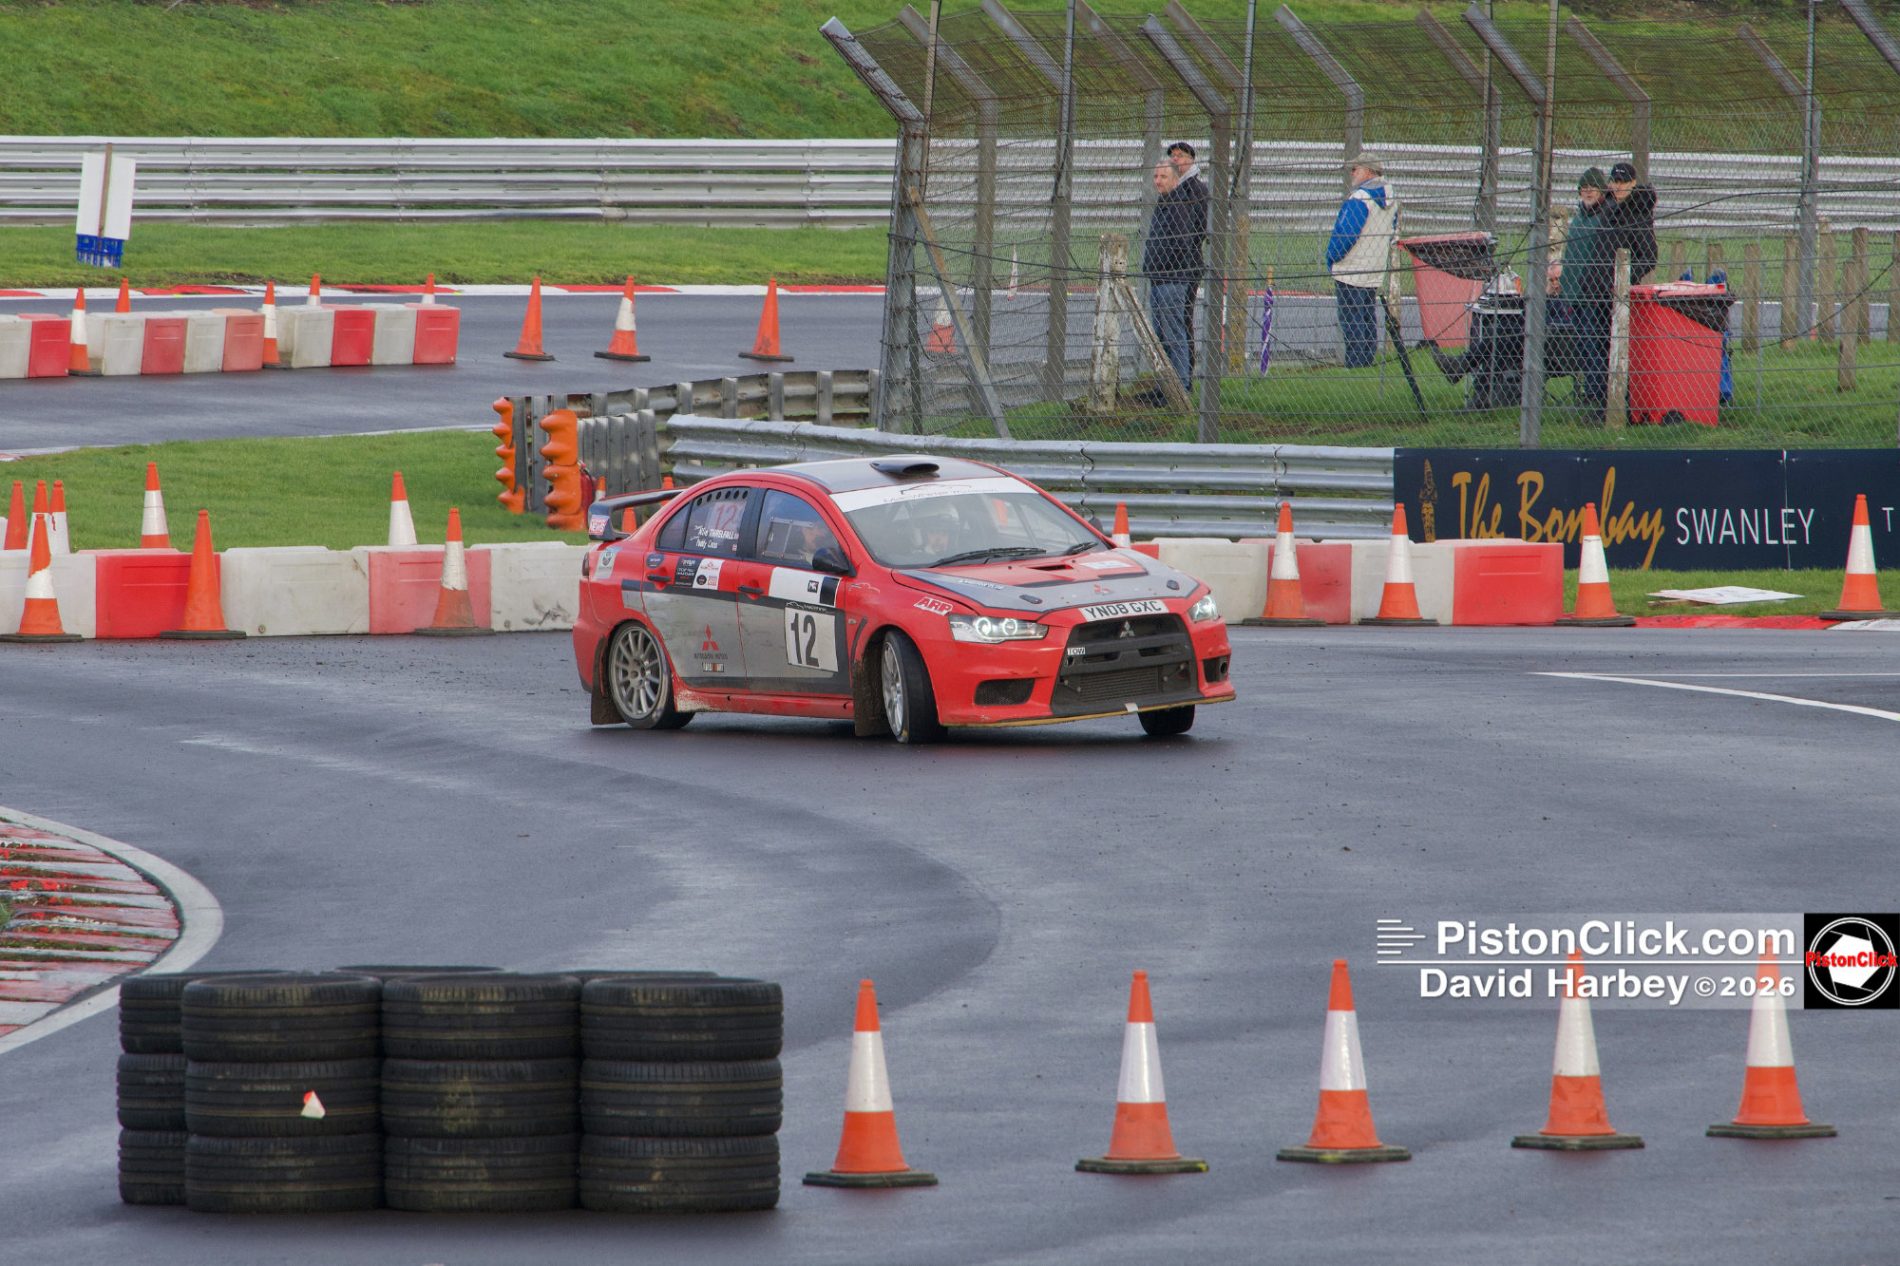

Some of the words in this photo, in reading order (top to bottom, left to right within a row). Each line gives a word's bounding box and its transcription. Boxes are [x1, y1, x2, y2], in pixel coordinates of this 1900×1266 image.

[715, 503, 738, 530] 12
[1452, 471, 1505, 540] The
[1516, 466, 1665, 571] Bombay
[1676, 507, 1814, 545] SWANLEY
[915, 597, 953, 614] ARP
[1085, 603, 1129, 618] YN08
[1130, 600, 1162, 613] GXC
[790, 612, 820, 668] 12
[1068, 647, 1085, 656] TOW
